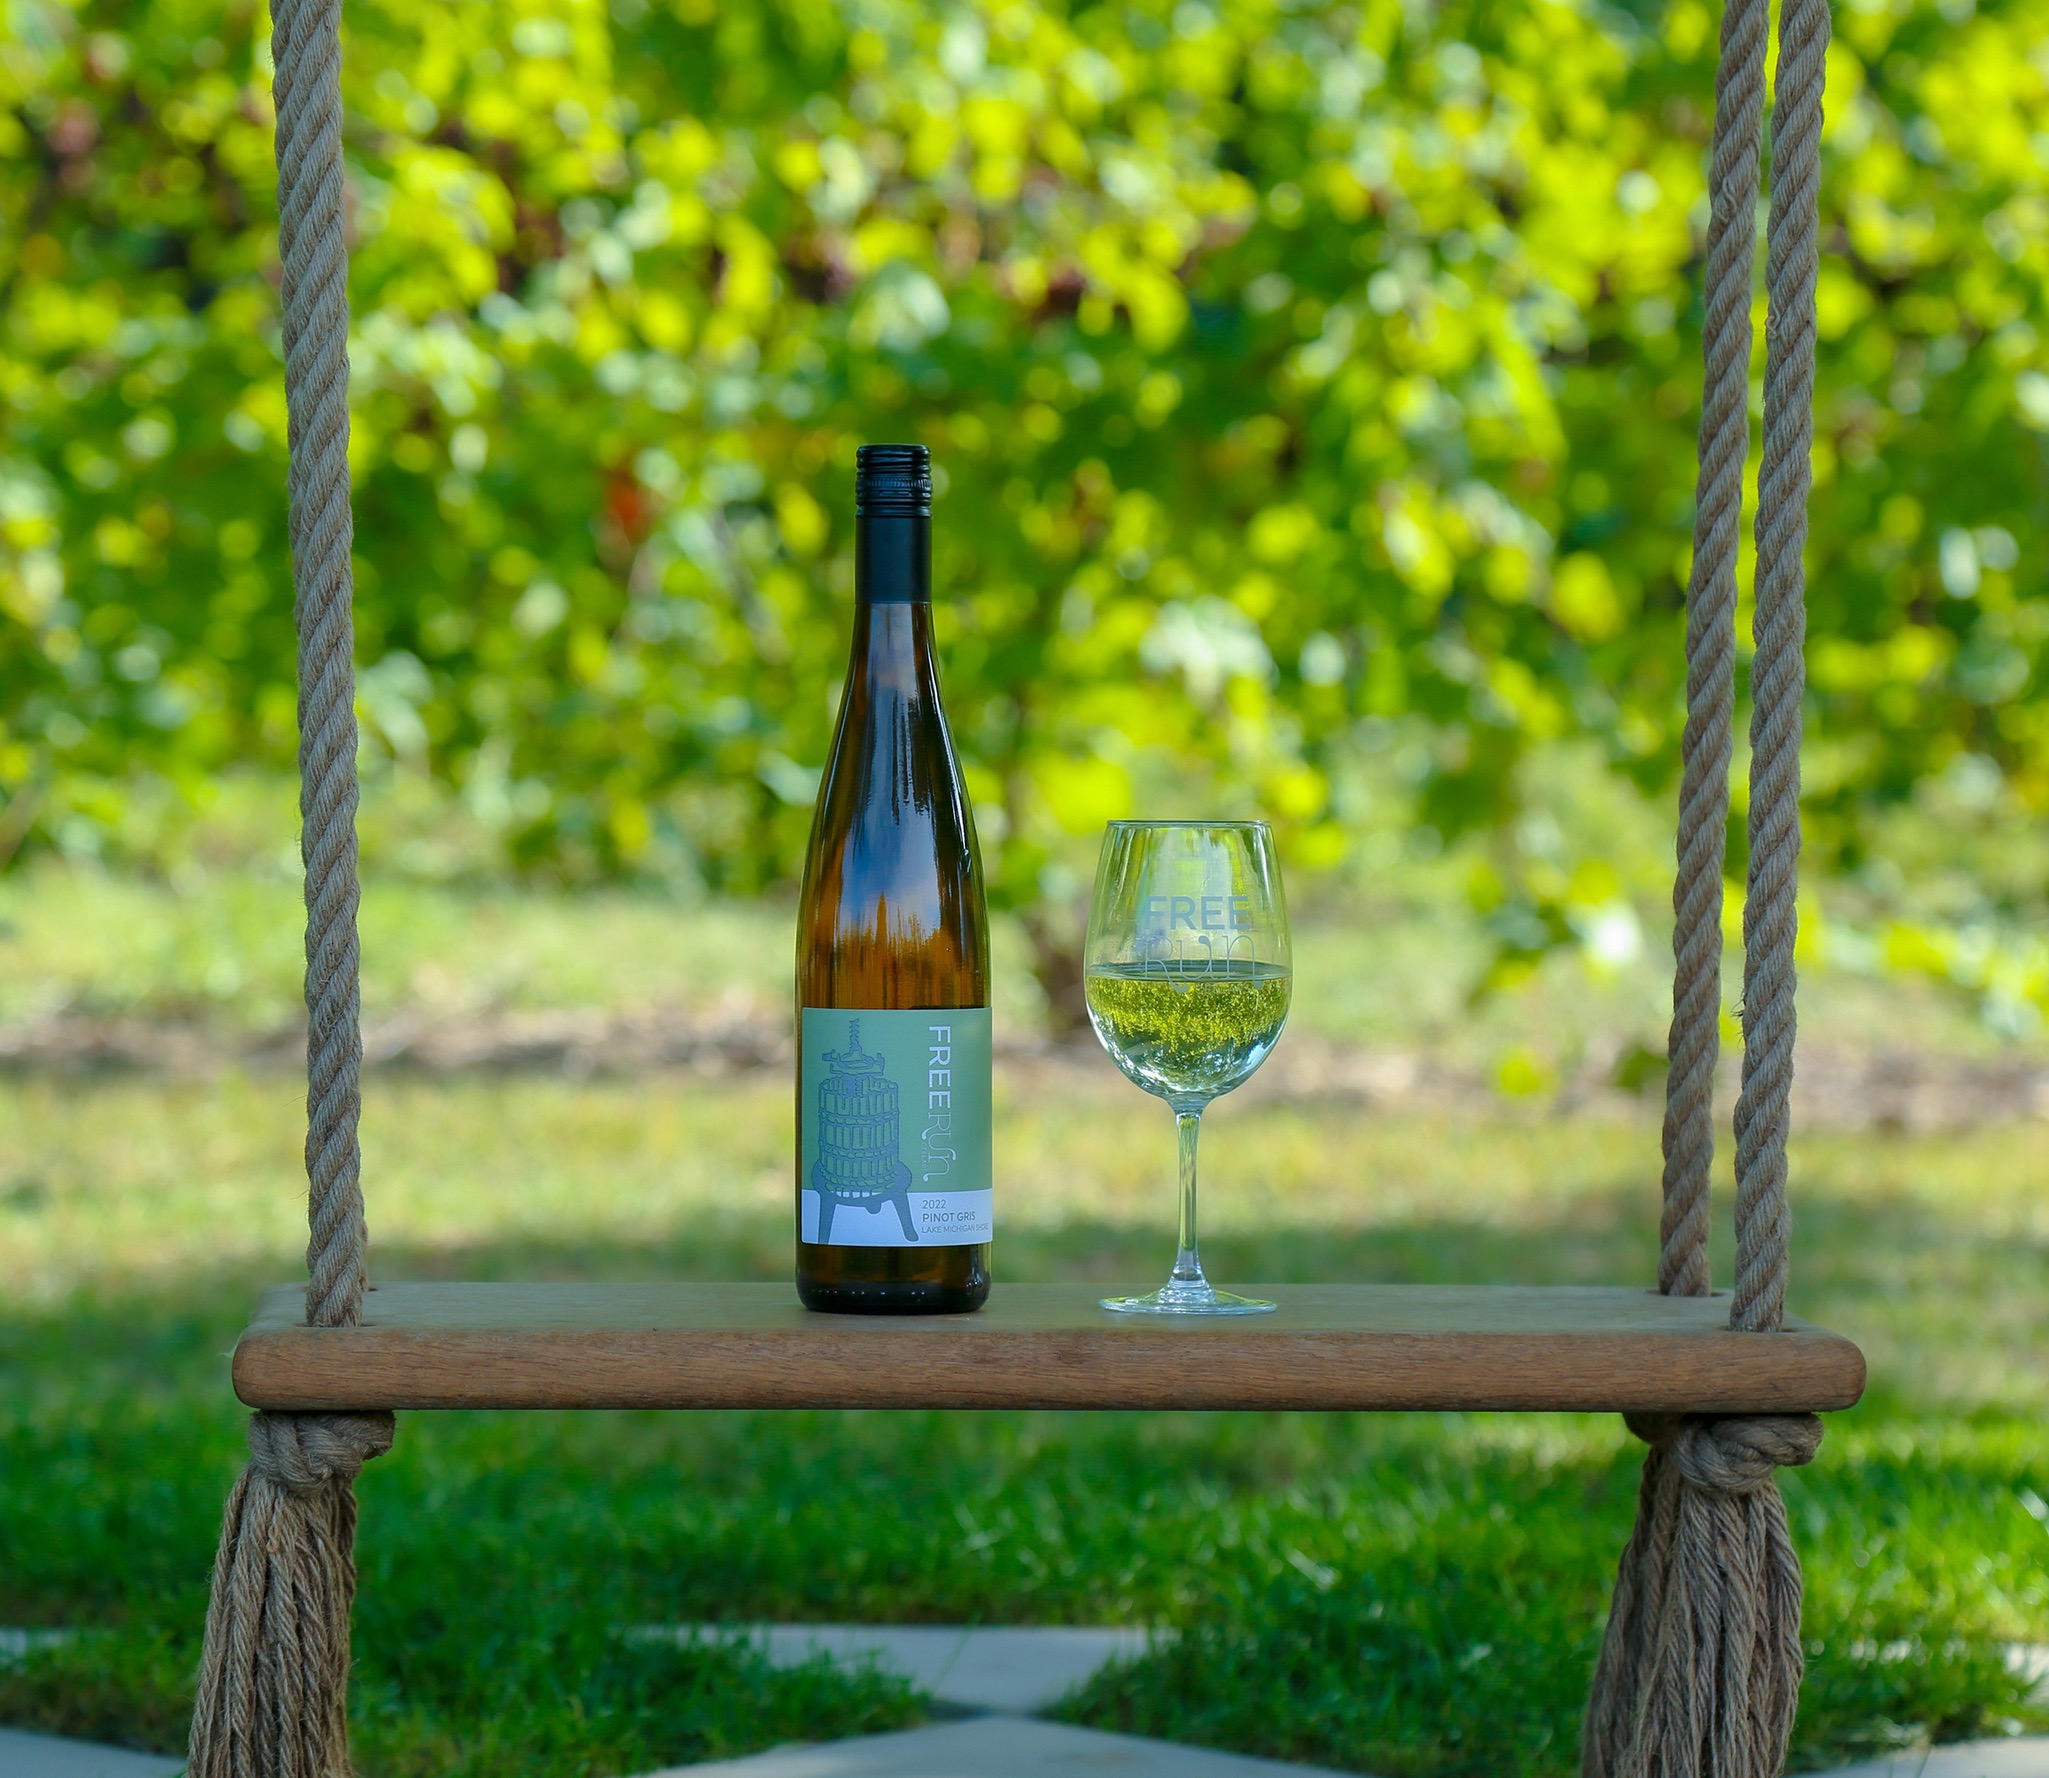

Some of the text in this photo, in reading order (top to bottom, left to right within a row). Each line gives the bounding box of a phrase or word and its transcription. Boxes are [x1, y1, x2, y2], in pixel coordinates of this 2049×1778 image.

[1144, 895, 1252, 930] FREE
[928, 1025, 951, 1110] FREE
[922, 1199, 947, 1210] 2022
[922, 1211, 976, 1223] PINOT GRIS
[921, 1226, 942, 1234] LAKE
[943, 1224, 975, 1233] MICHIGAN
